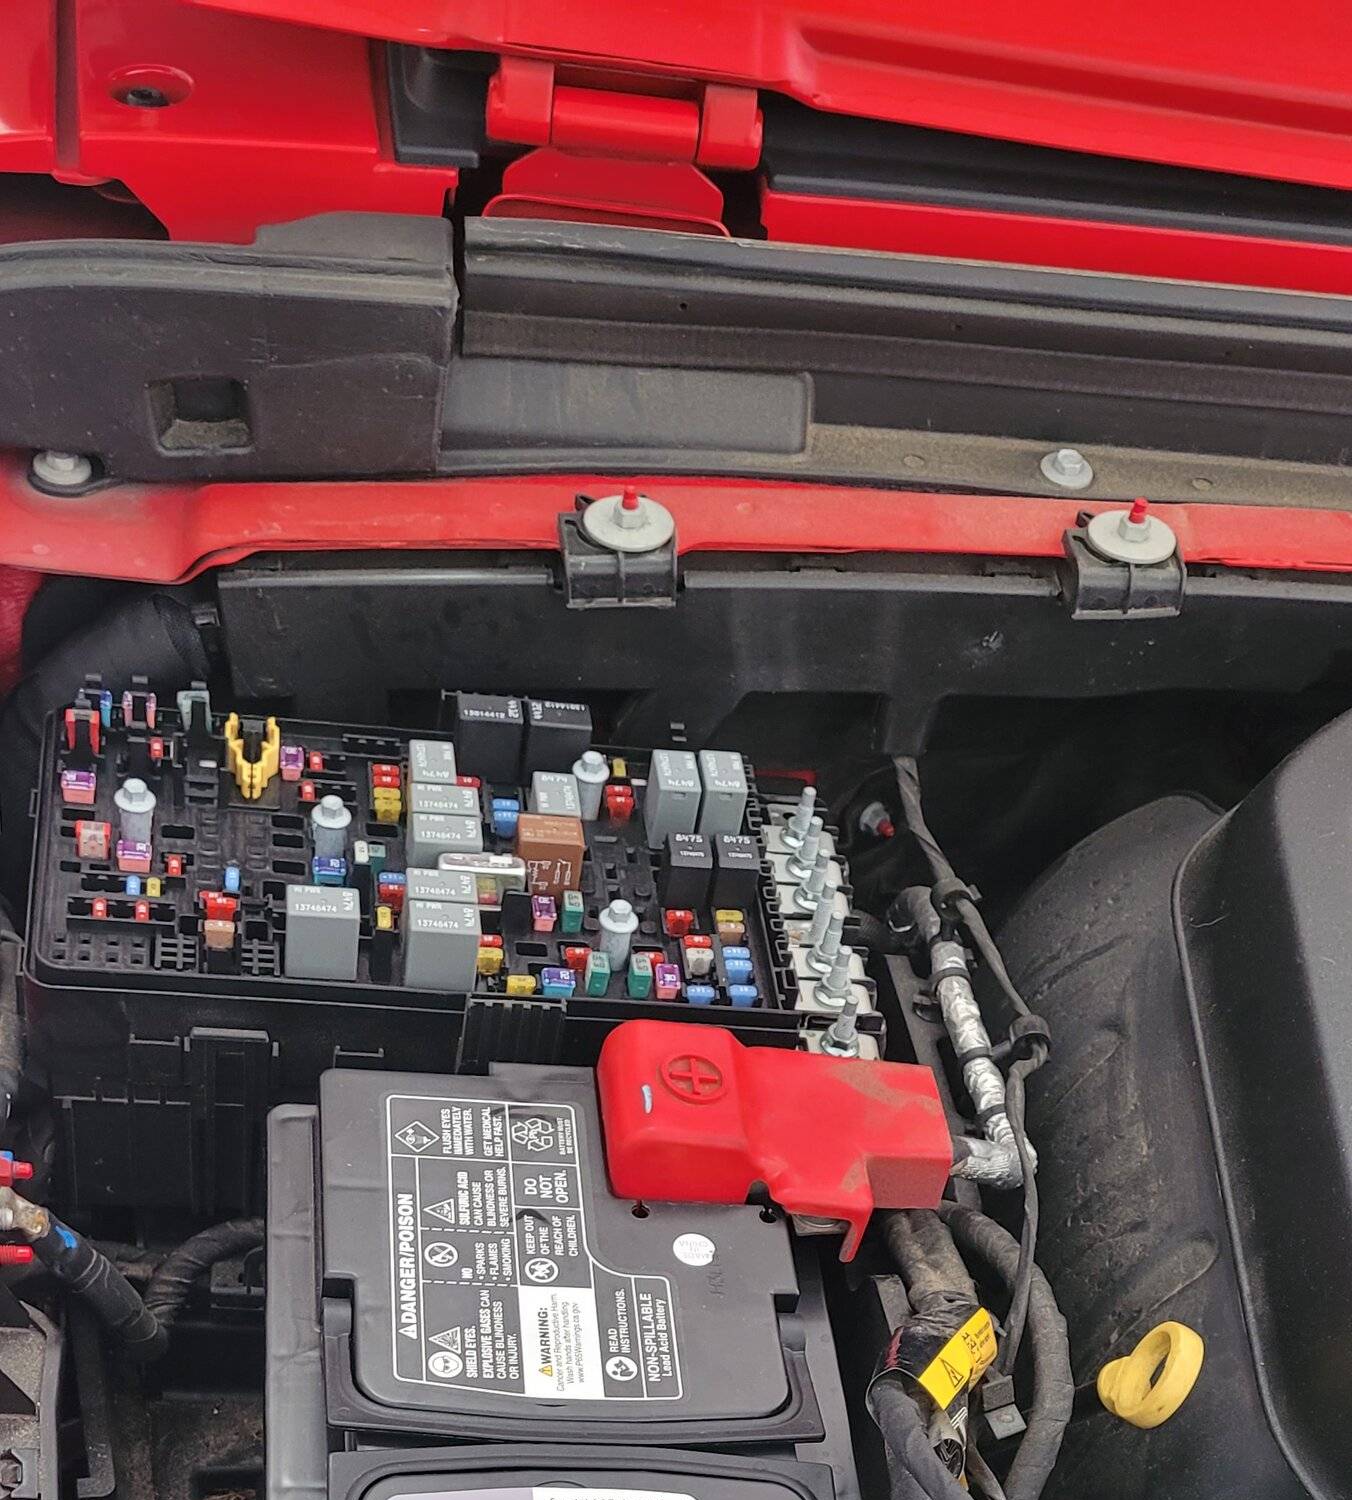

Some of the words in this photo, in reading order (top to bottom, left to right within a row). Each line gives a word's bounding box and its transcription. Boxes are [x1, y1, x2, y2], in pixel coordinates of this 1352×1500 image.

[675, 834, 703, 842] 8475
[723, 835, 750, 844] 8475
[441, 1109, 450, 1128] EYES
[452, 1106, 463, 1154] IMMEDIATELY
[463, 1108, 473, 1135] WATER.
[482, 1107, 492, 1139] MEDICAL
[493, 1116, 503, 1136] FAST.
[442, 1130, 452, 1154] FLUSH
[465, 1136, 474, 1155] WITH
[484, 1141, 493, 1156] GET
[494, 1137, 504, 1157] HELP
[457, 1171, 468, 1189] ACID
[484, 1170, 494, 1181] OR
[497, 1167, 507, 1195] BURNS.
[524, 1178, 537, 1195] DO
[539, 1175, 553, 1199] NOT
[554, 1170, 569, 1203] OPEN.
[472, 1182, 482, 1208] CAUSE
[486, 1183, 496, 1227] BLINDNESS
[458, 1190, 470, 1225] SULFURIC
[473, 1209, 483, 1226] CAN
[499, 1196, 509, 1227] SEVERE
[524, 1215, 534, 1231] OUT
[552, 1215, 561, 1227] OF
[525, 1233, 536, 1255] KEEP
[539, 1227, 549, 1244] THE
[554, 1228, 564, 1255] REACH
[566, 1215, 578, 1256] CHILDREN.
[397, 1193, 417, 1324] DANGER/POISON
[475, 1242, 486, 1274] SPARKS
[488, 1243, 499, 1275] FLAMES
[501, 1238, 512, 1276] SMOKING
[541, 1244, 550, 1255] OF
[461, 1268, 473, 1279] NO
[480, 1290, 490, 1307] CAN
[479, 1309, 492, 1334] GASES
[493, 1301, 505, 1348] BLINDNESS
[615, 1288, 631, 1353] INSTRUCTIONS.
[655, 1299, 668, 1330] Battery
[464, 1325, 477, 1348] EYES.
[538, 1307, 551, 1364] WARNING:
[551, 1313, 563, 1353] Reproductive
[563, 1329, 571, 1343] after
[608, 1328, 619, 1352] READ
[639, 1293, 661, 1382] NON-SPILLABLE
[658, 1332, 670, 1353] Acid
[481, 1336, 494, 1379] EXPLOSIVE
[507, 1334, 518, 1364] INJURY.
[554, 1355, 562, 1366] and
[565, 1345, 573, 1364] hands
[465, 1350, 478, 1378] SHIELD
[496, 1350, 507, 1379] CAUSE
[509, 1366, 519, 1379] OR
[566, 1366, 574, 1384] Wash
[660, 1354, 672, 1376] Lead
[556, 1368, 565, 1392] Cancer
